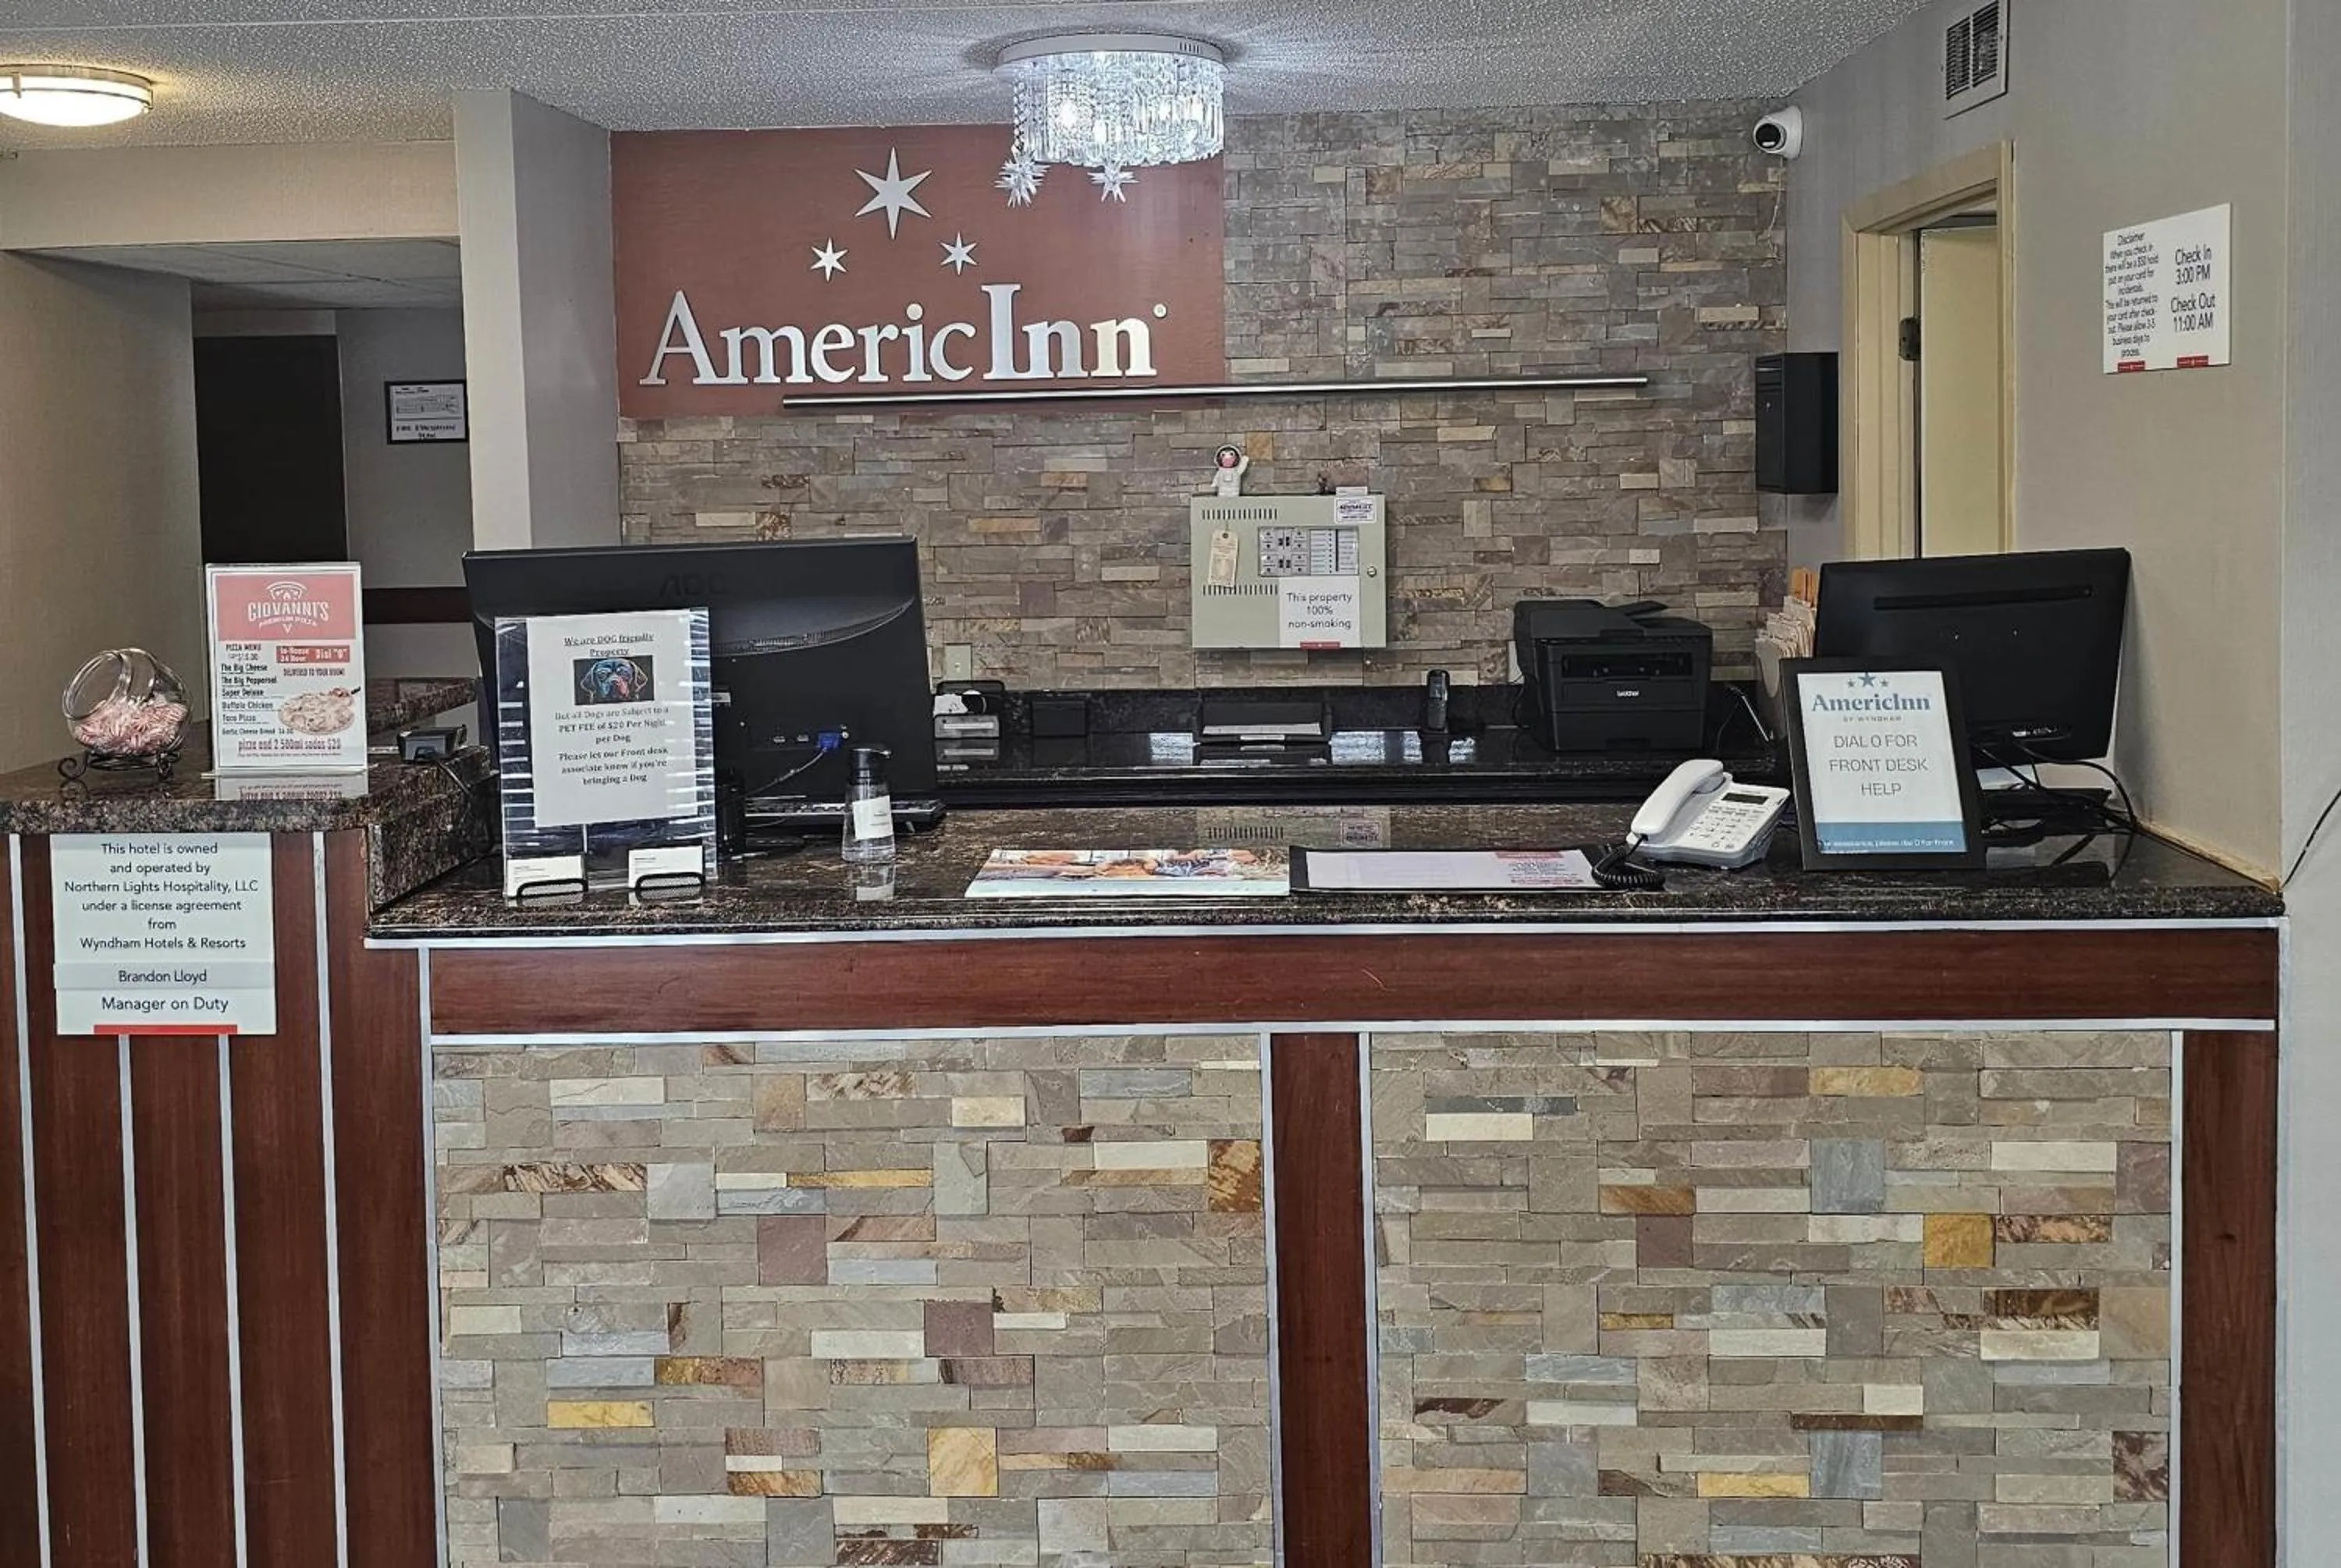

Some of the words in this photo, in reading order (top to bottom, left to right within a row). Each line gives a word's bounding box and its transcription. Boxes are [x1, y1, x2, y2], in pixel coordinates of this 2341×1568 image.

[2176, 245, 2201, 264] Check
[2204, 244, 2211, 260] In
[2176, 268, 2194, 285] 3:00
[2196, 264, 2210, 281] PM
[2171, 293, 2197, 314] Check
[2198, 293, 2215, 308] Out
[2173, 315, 2195, 332] 11:00
[2197, 313, 2214, 329] AM
[639, 284, 1156, 385] AmericInn
[1287, 592, 1306, 602] This
[1309, 592, 1352, 606] property
[248, 601, 329, 621] GIOVANNI'S
[1306, 605, 1334, 615] 100%
[1288, 618, 1352, 630] non-smoking
[563, 637, 578, 646] We
[597, 636, 617, 644] DOG
[234, 664, 243, 672] Big
[246, 663, 268, 672] Cheese
[234, 677, 243, 686] Big
[1812, 694, 1931, 711] AmericInn
[607, 721, 625, 729] $20
[613, 734, 631, 743] Dog
[1834, 735, 1867, 748] DIAL
[1885, 734, 1917, 747] FOR
[1829, 758, 1881, 772] FRONT
[1886, 758, 1927, 771] DESK
[583, 775, 621, 786] bringing
[630, 774, 647, 782] Dog
[1861, 782, 1901, 796] HELP
[101, 843, 125, 854] This
[129, 843, 160, 854] hotel
[164, 843, 173, 854] is
[176, 843, 218, 854] owned
[109, 862, 132, 873] and
[136, 862, 192, 876] operated
[197, 862, 211, 876] by
[65, 881, 119, 892] Northern
[123, 881, 159, 895] Lights
[164, 880, 231, 895] Hospitality,
[235, 880, 259, 891] LLC
[82, 900, 117, 911] under
[120, 903, 127, 911] a
[131, 900, 172, 911] license
[176, 900, 241, 913] agreement
[148, 919, 176, 929] from
[80, 938, 140, 952] Wyndham
[144, 938, 183, 949] Hotels
[187, 938, 197, 949] &
[201, 938, 246, 949] Resorts
[119, 970, 170, 982] Brandon
[175, 970, 207, 985] Lloyd
[101, 997, 165, 1013] Manager
[171, 999, 189, 1010] on
[194, 997, 229, 1013] Duty
